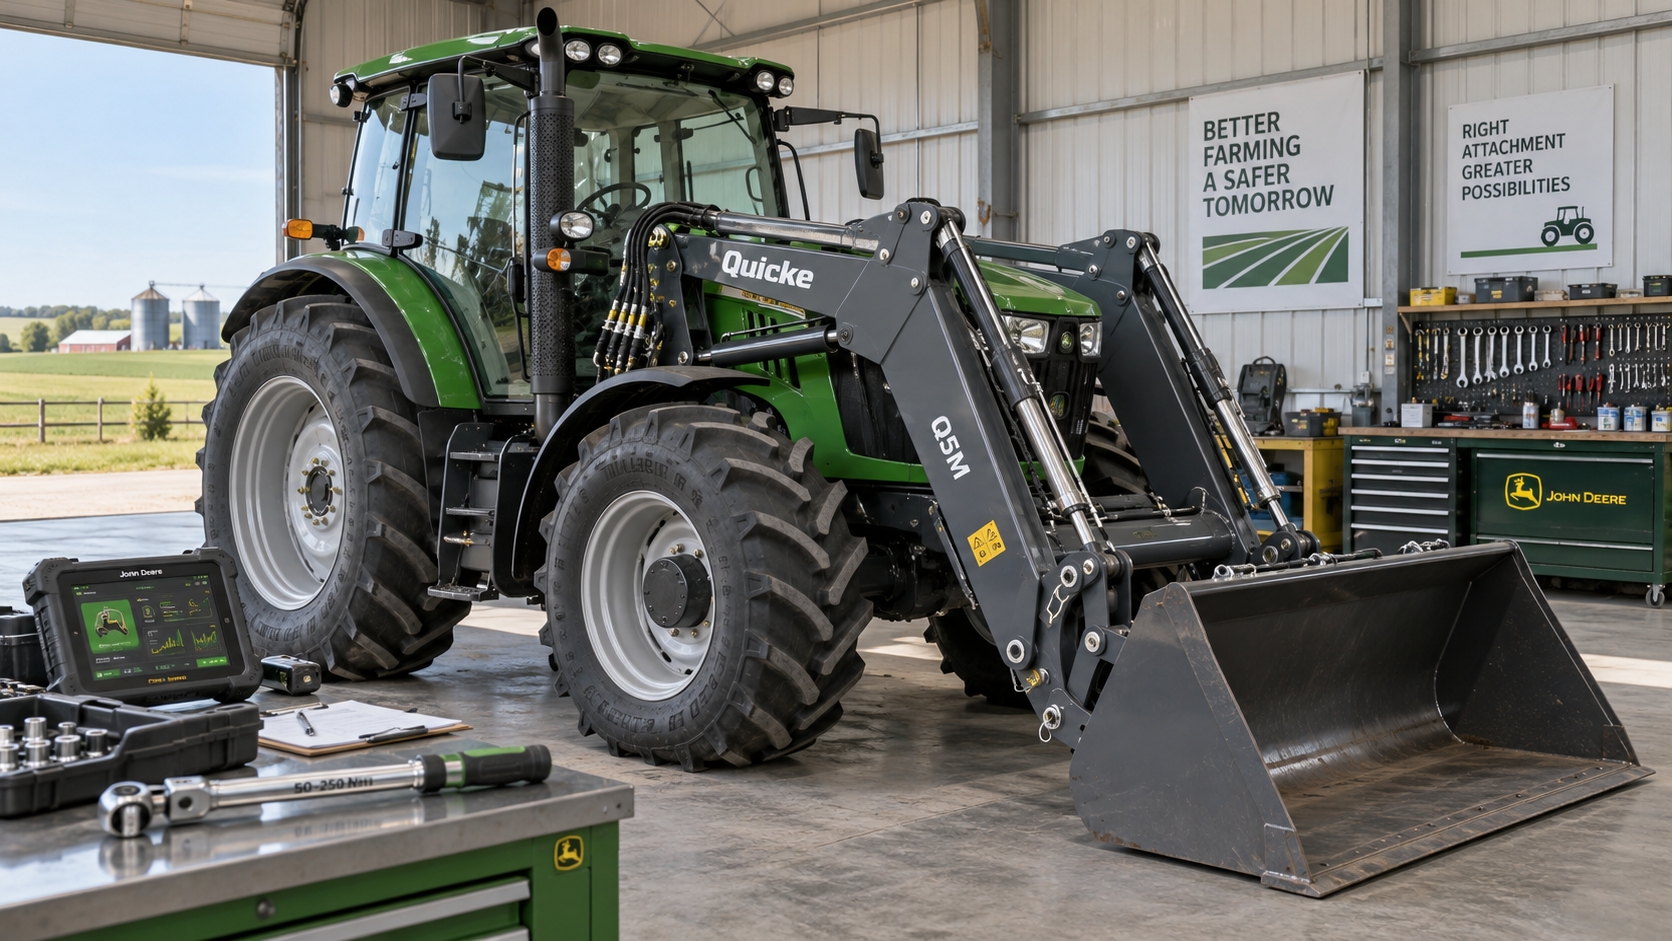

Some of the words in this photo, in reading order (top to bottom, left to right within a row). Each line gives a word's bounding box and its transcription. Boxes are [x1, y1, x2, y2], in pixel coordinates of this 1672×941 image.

[1203, 111, 1281, 142] BETTER
[1462, 118, 1510, 140] RIGHT
[1204, 134, 1301, 167] FARMING
[1461, 132, 1566, 159] ATTACHMENT
[1203, 171, 1217, 193] A
[1224, 163, 1290, 191] SAFER
[1462, 158, 1533, 180] GREATER
[1202, 184, 1335, 218] TOMORROW
[1461, 176, 1571, 201] POSSIBILITIES
[721, 249, 814, 290] Quicke
[931, 415, 971, 481] Q5M
[1546, 490, 1581, 503] JOHN
[1583, 491, 1627, 505] DEERE
